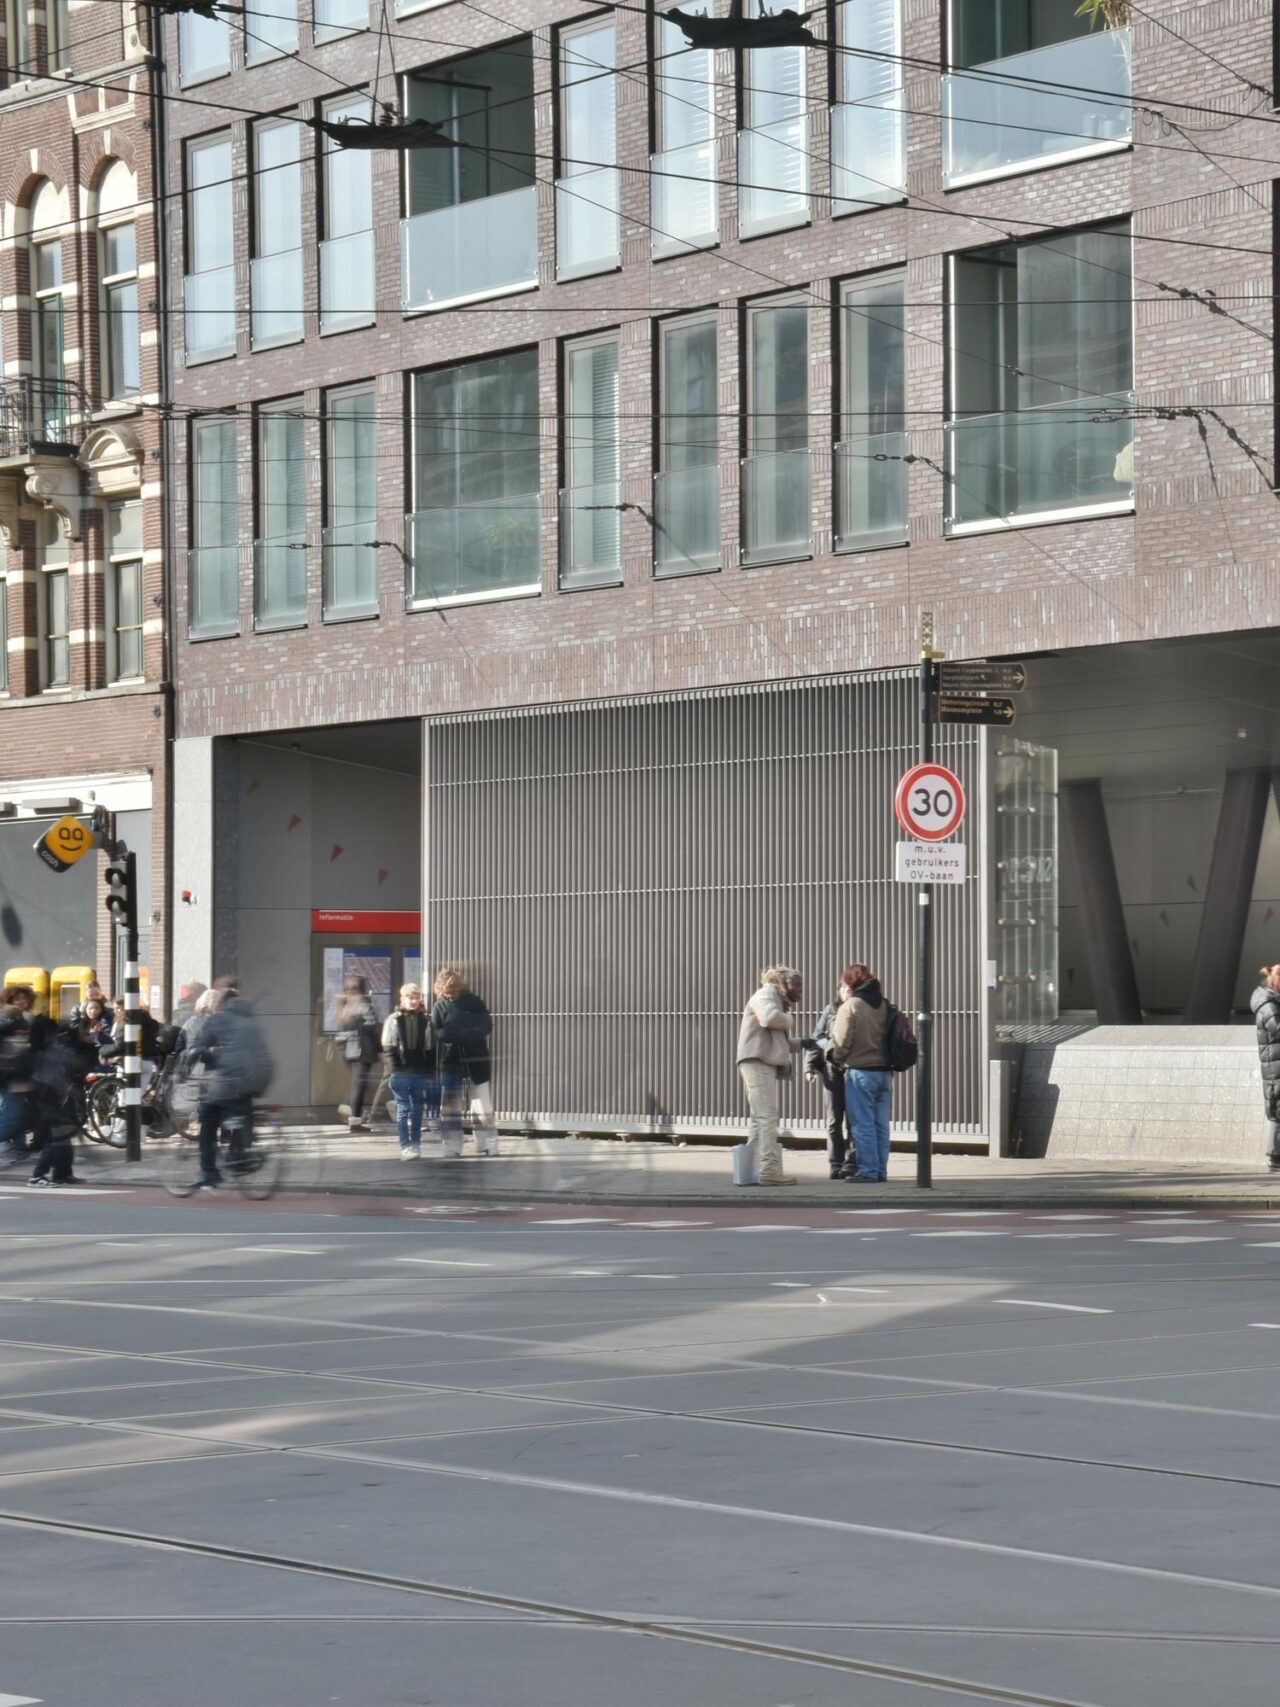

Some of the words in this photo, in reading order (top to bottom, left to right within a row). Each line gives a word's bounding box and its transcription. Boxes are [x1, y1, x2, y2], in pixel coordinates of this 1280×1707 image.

[912, 788, 954, 818] 30
[41, 850, 59, 868] cash
[904, 857, 960, 868] gebruikers
[910, 870, 954, 881] OV-baan
[319, 913, 354, 921] Informatie
